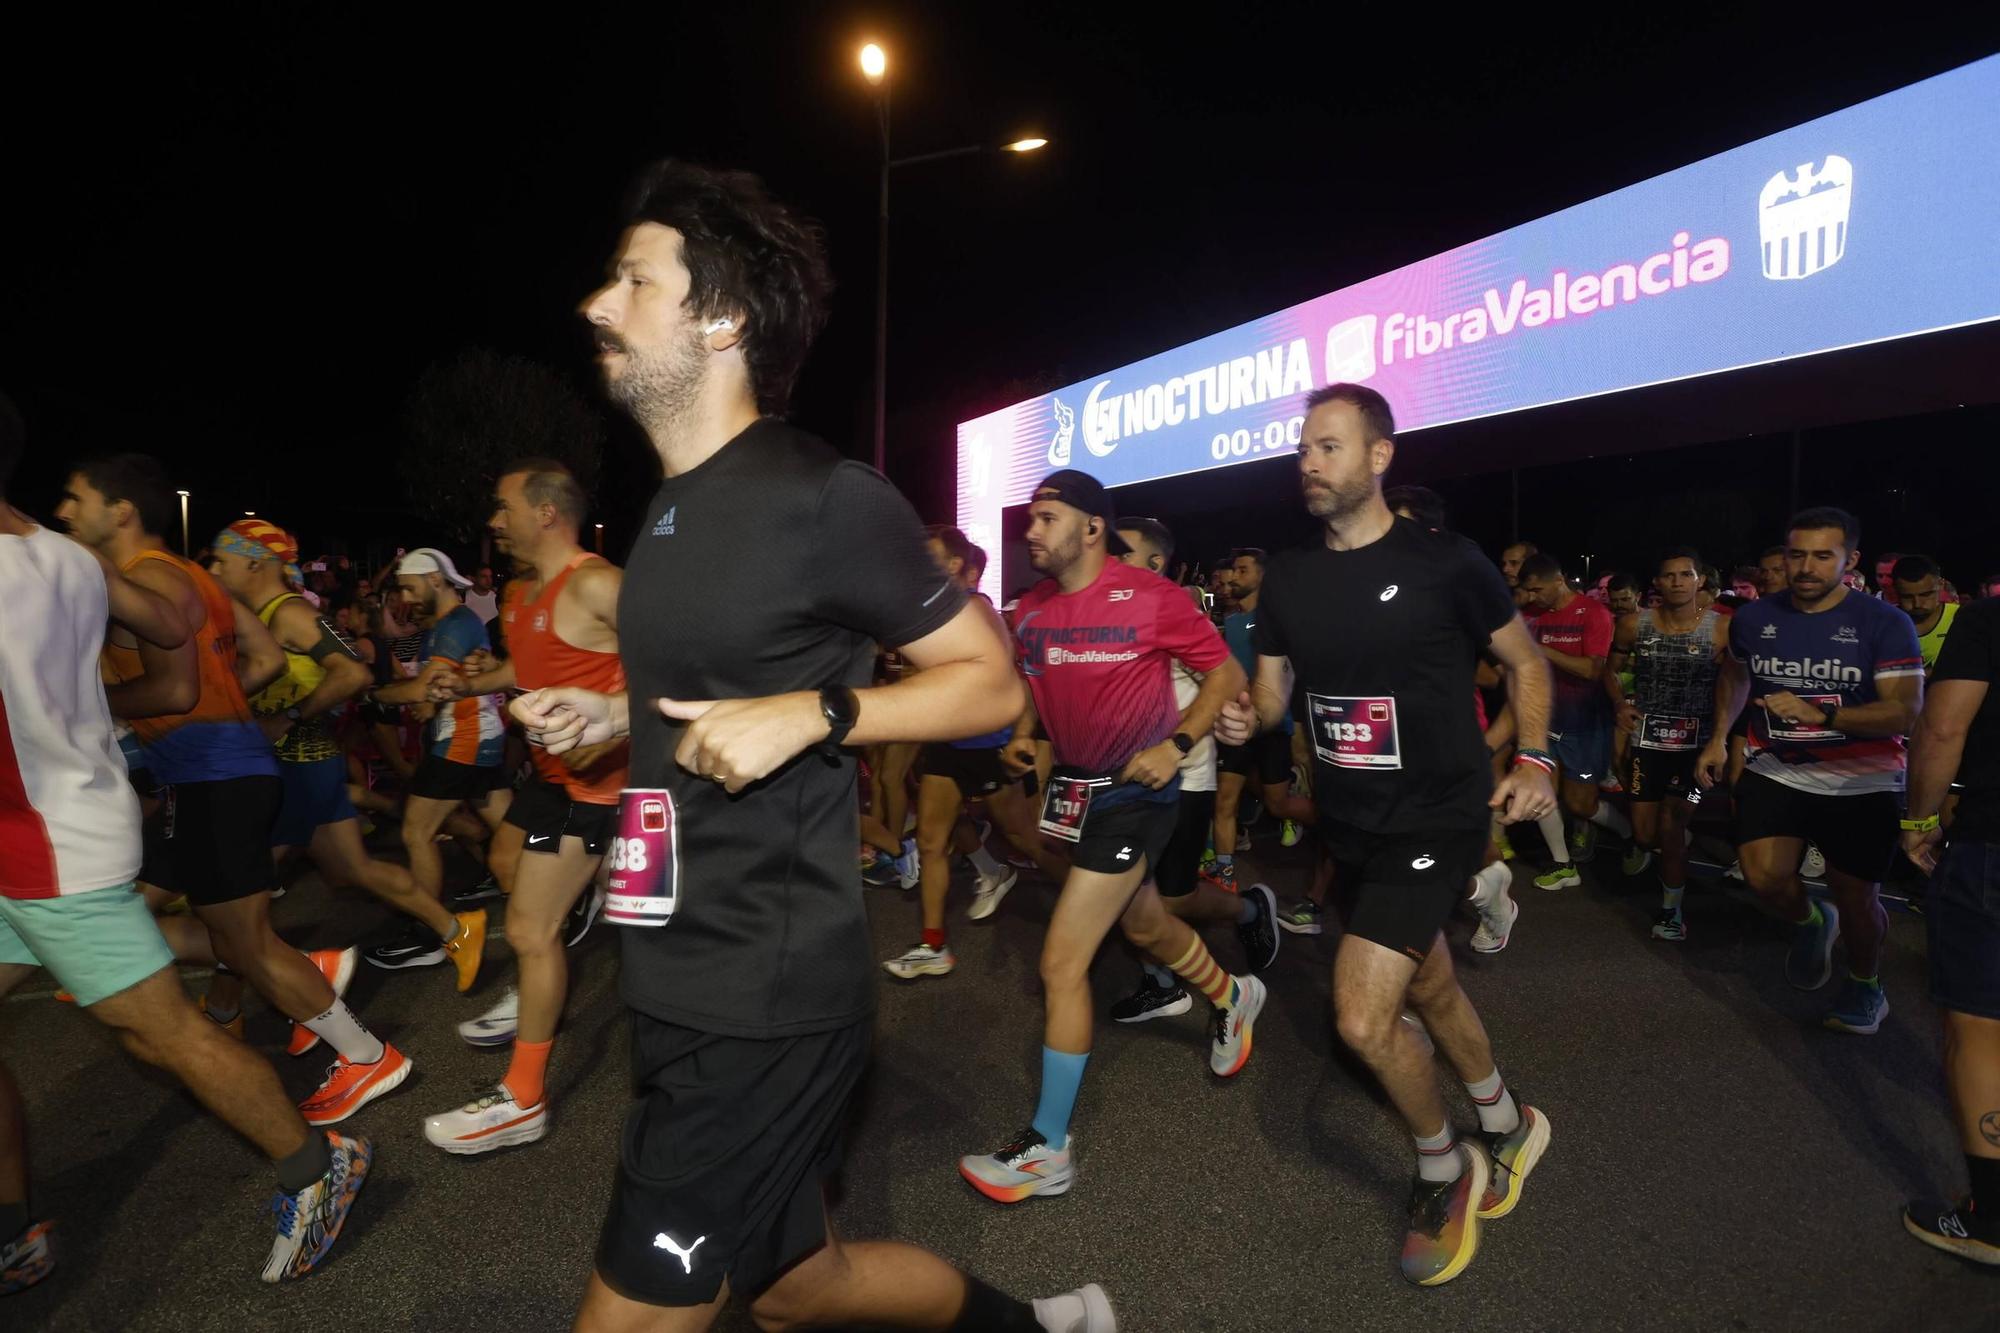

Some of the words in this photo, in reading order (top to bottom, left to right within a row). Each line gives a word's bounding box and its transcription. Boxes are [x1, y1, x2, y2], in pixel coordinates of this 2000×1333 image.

[1382, 231, 1730, 365] fibraValencia
[1124, 338, 1314, 437] NOCTURNA
[1324, 720, 1373, 742] 1133
[644, 804, 662, 814] SUB
